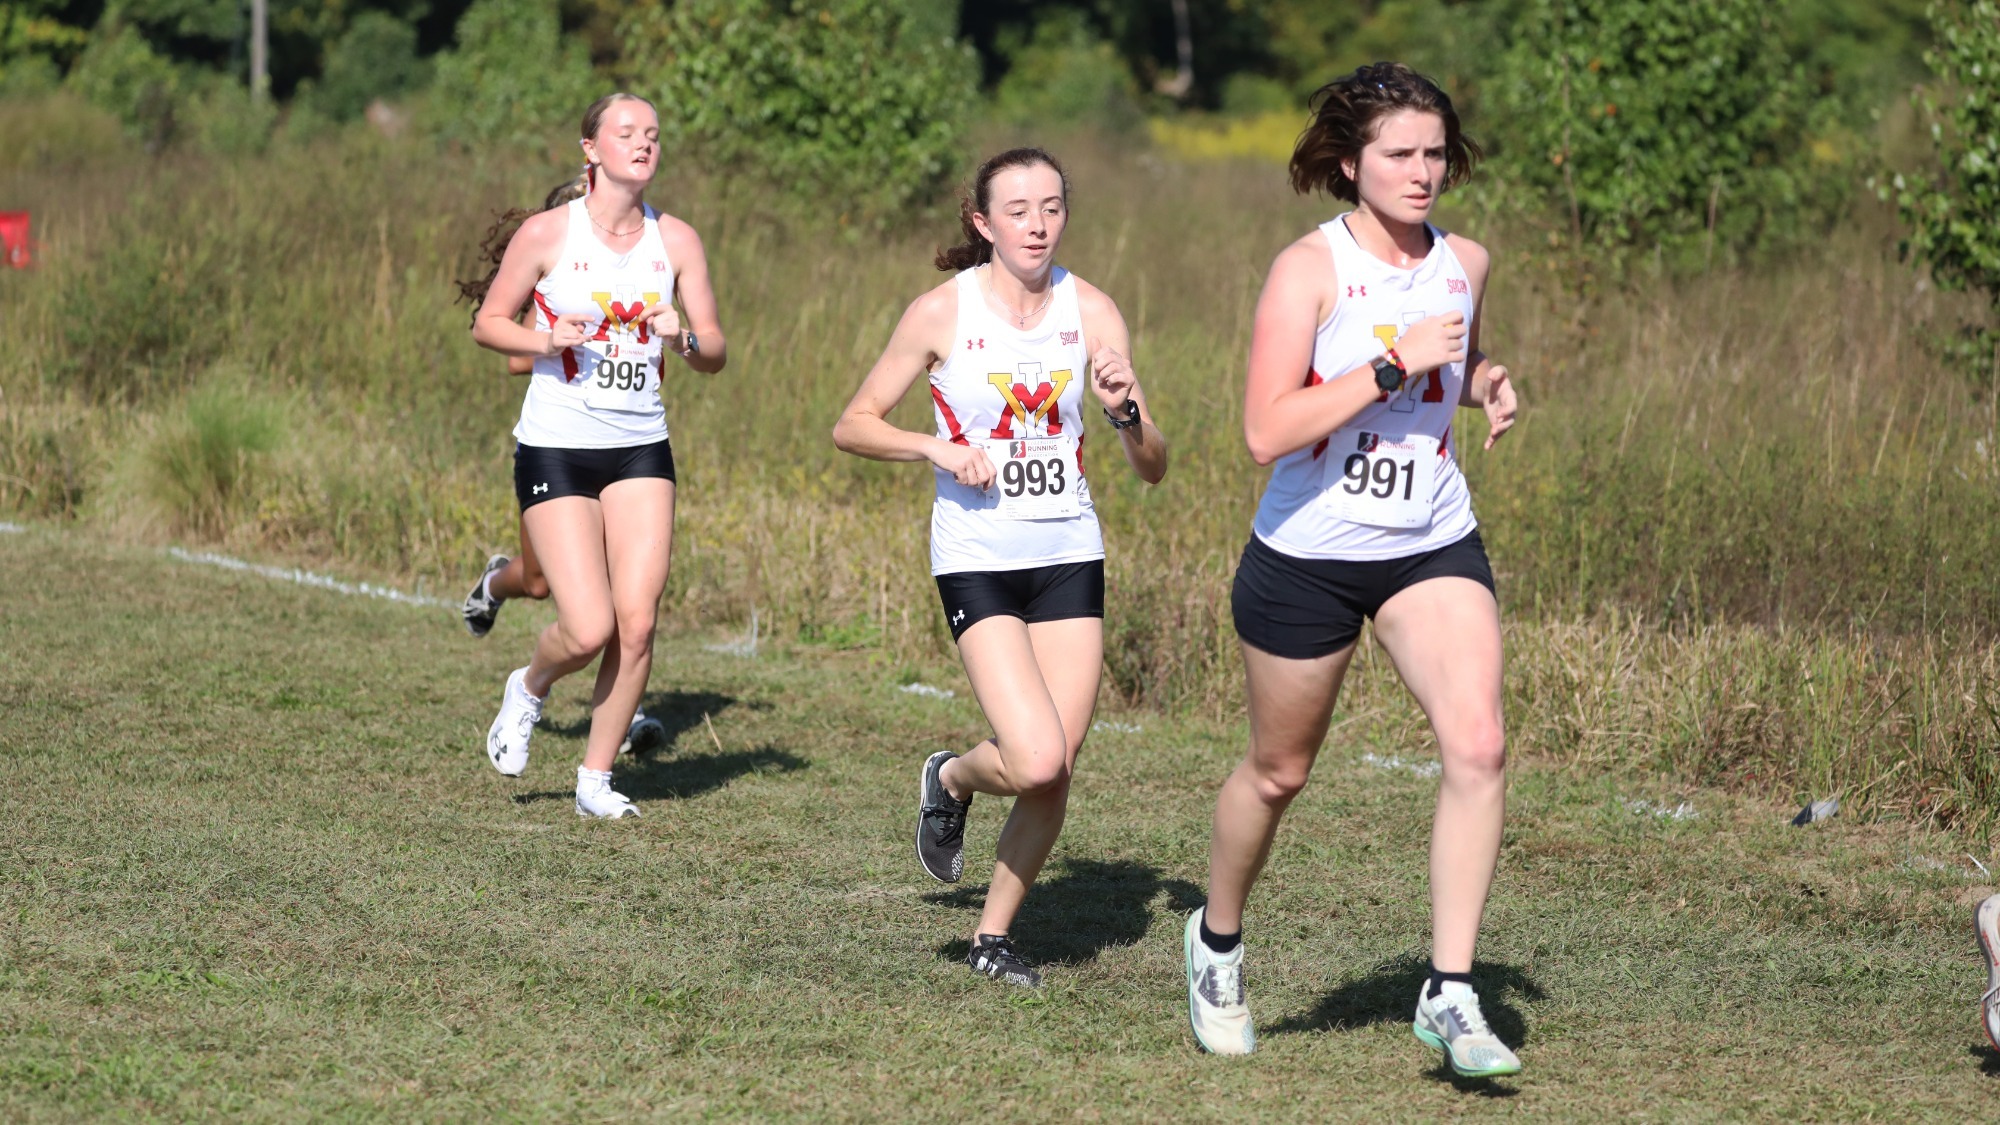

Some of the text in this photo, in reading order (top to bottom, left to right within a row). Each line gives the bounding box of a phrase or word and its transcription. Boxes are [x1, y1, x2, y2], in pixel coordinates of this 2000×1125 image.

[597, 359, 647, 392] 995
[1028, 444, 1058, 452] RUNNING
[1003, 458, 1066, 498] 993
[1343, 453, 1415, 500] 991
